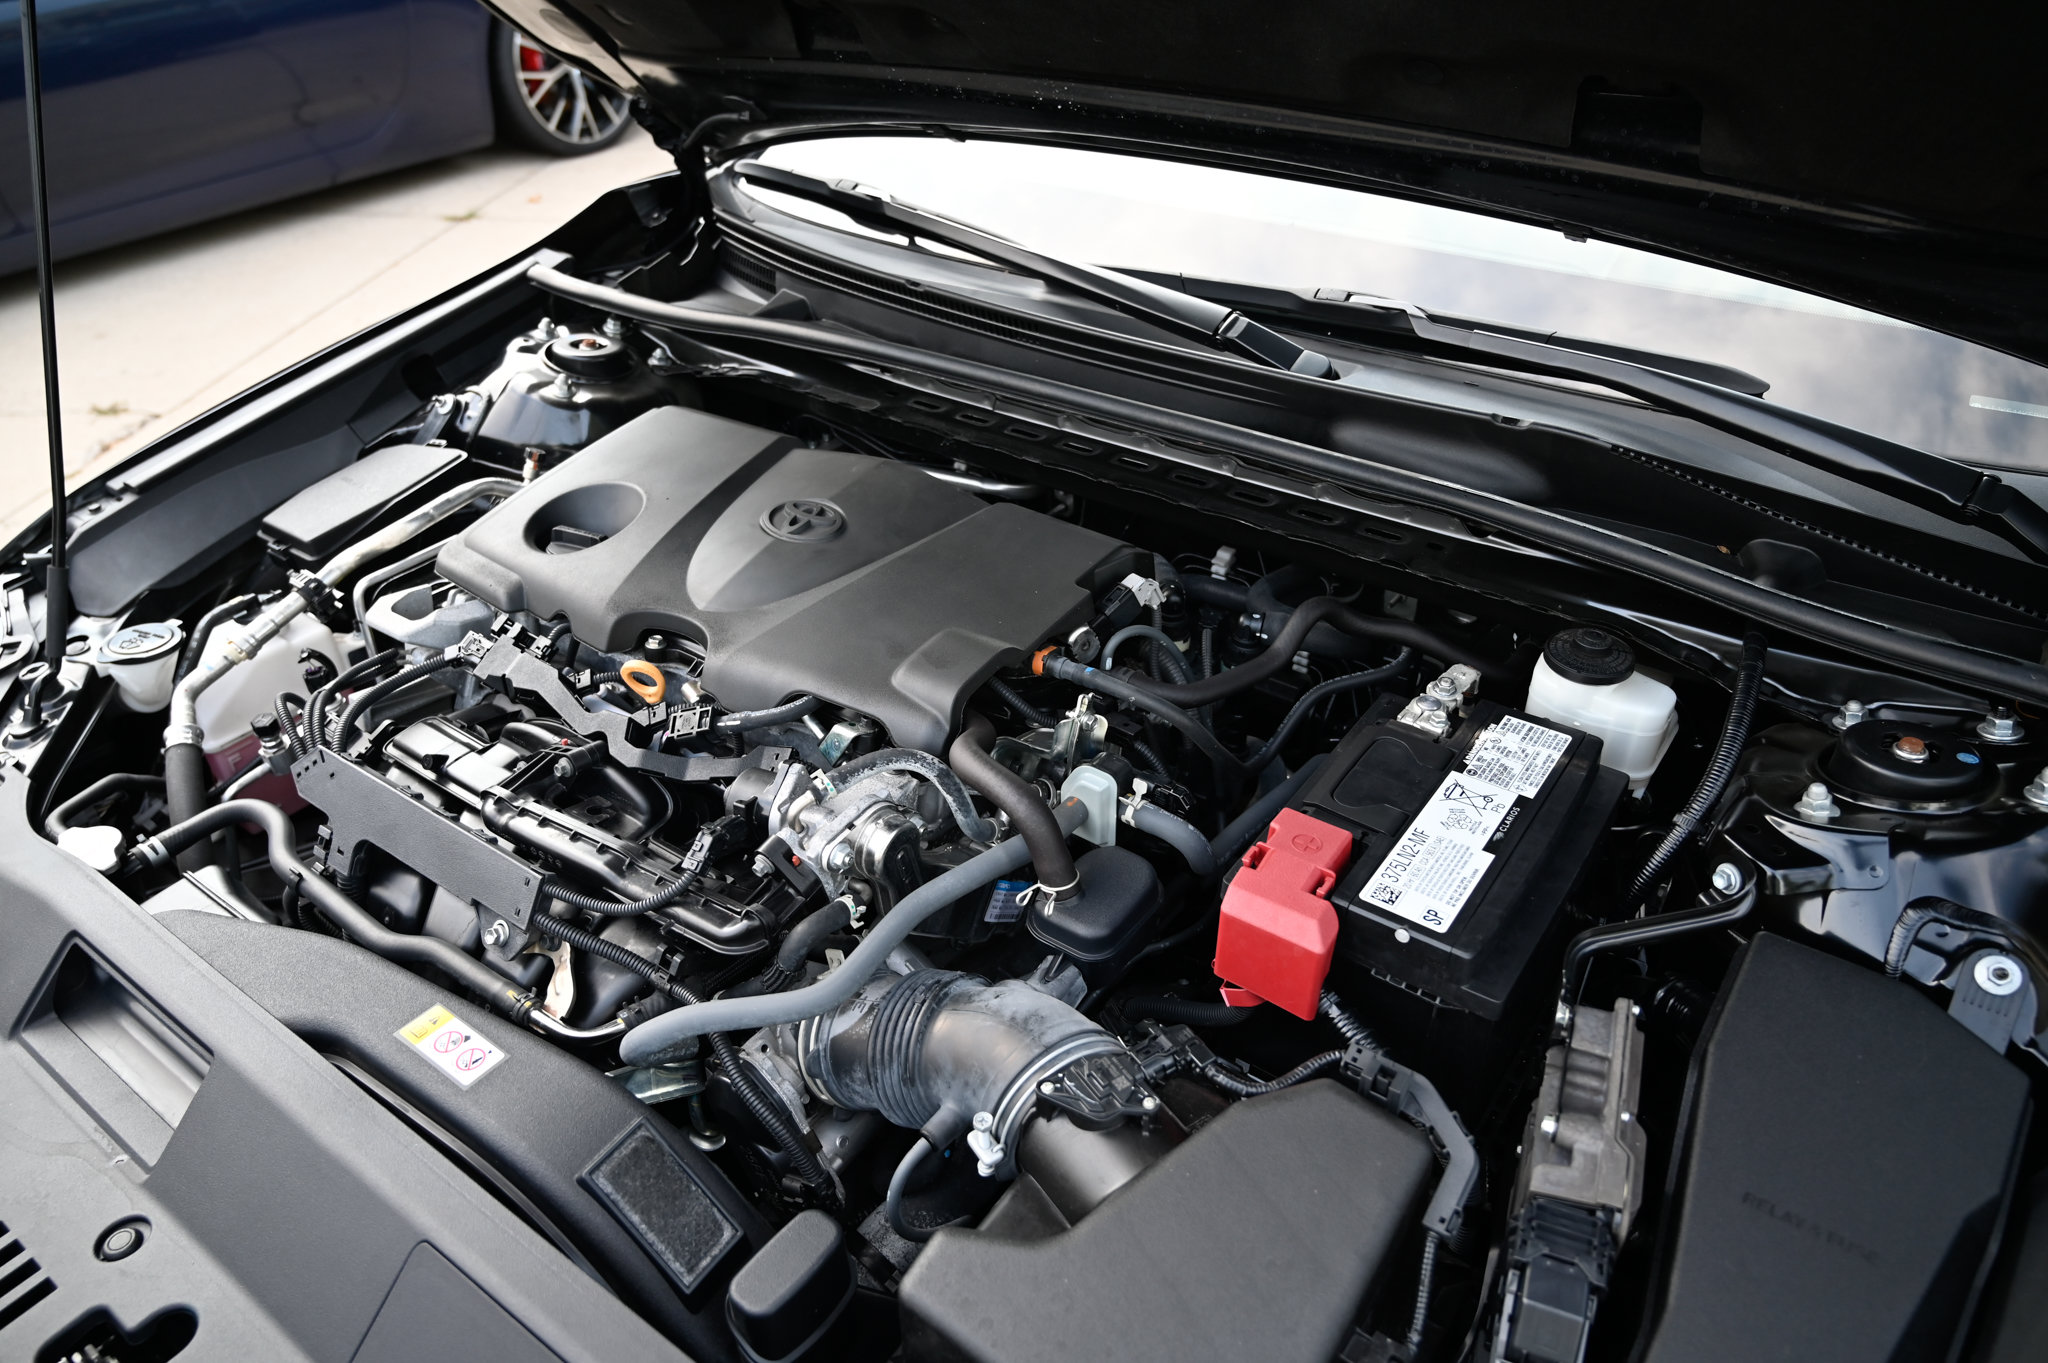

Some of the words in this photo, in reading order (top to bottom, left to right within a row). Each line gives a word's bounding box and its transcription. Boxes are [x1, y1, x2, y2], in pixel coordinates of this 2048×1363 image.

[1491, 803, 1506, 813] Pb
[1500, 806, 1520, 832] CLARIOS
[1381, 827, 1430, 883] 375LN2-MF
[1424, 909, 1445, 926] SP
[1742, 1192, 1805, 1229] RELAY
